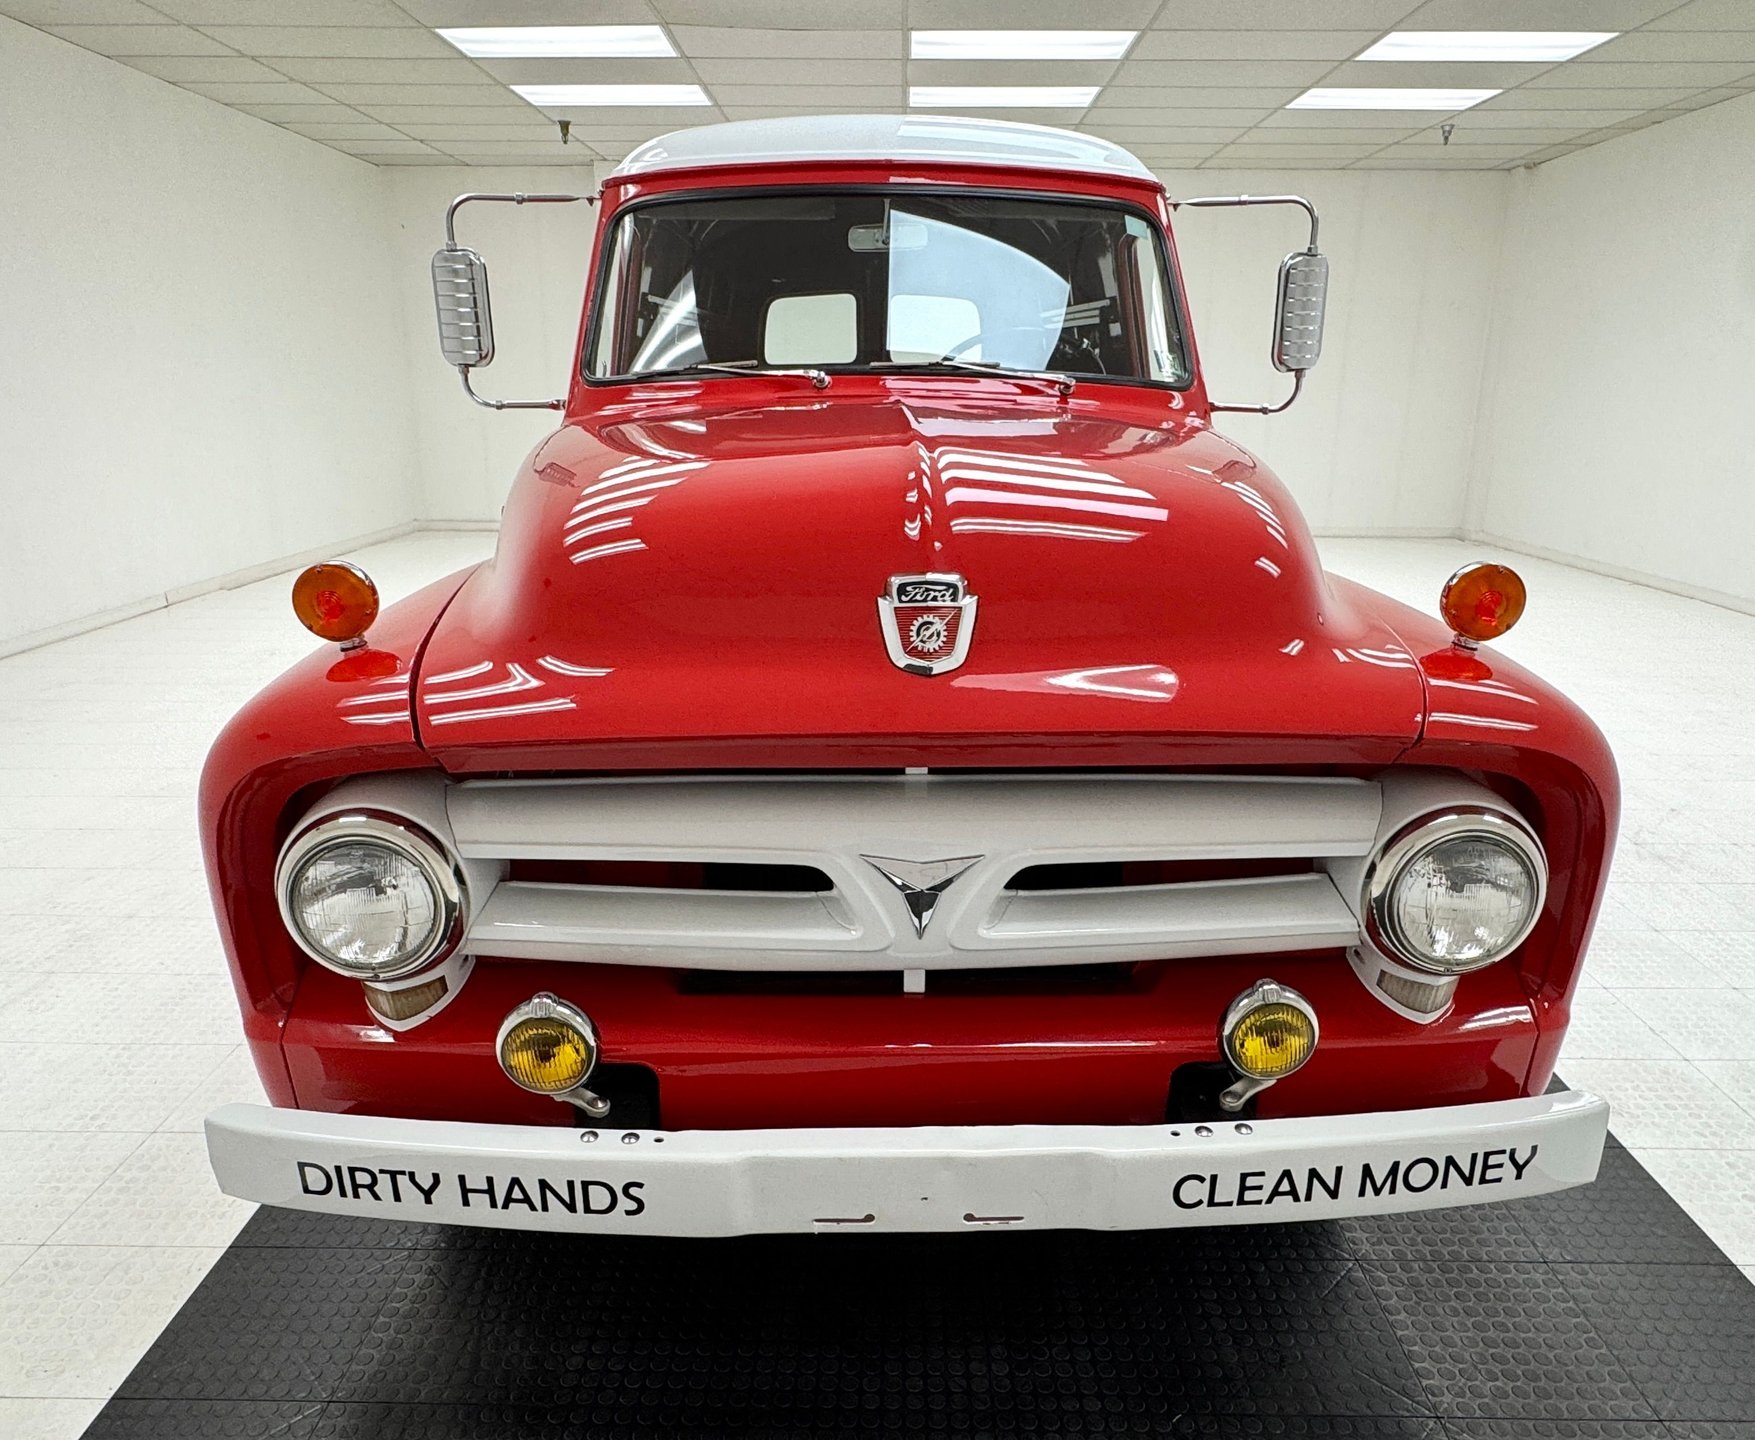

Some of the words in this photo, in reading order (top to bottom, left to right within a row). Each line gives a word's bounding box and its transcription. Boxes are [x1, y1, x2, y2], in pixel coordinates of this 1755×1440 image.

[901, 584, 954, 601] Ford
[297, 1161, 440, 1205] DIRTY
[457, 1174, 645, 1216] HANDS
[1172, 1165, 1343, 1209] CLEAN
[1358, 1144, 1539, 1198] MONEY
